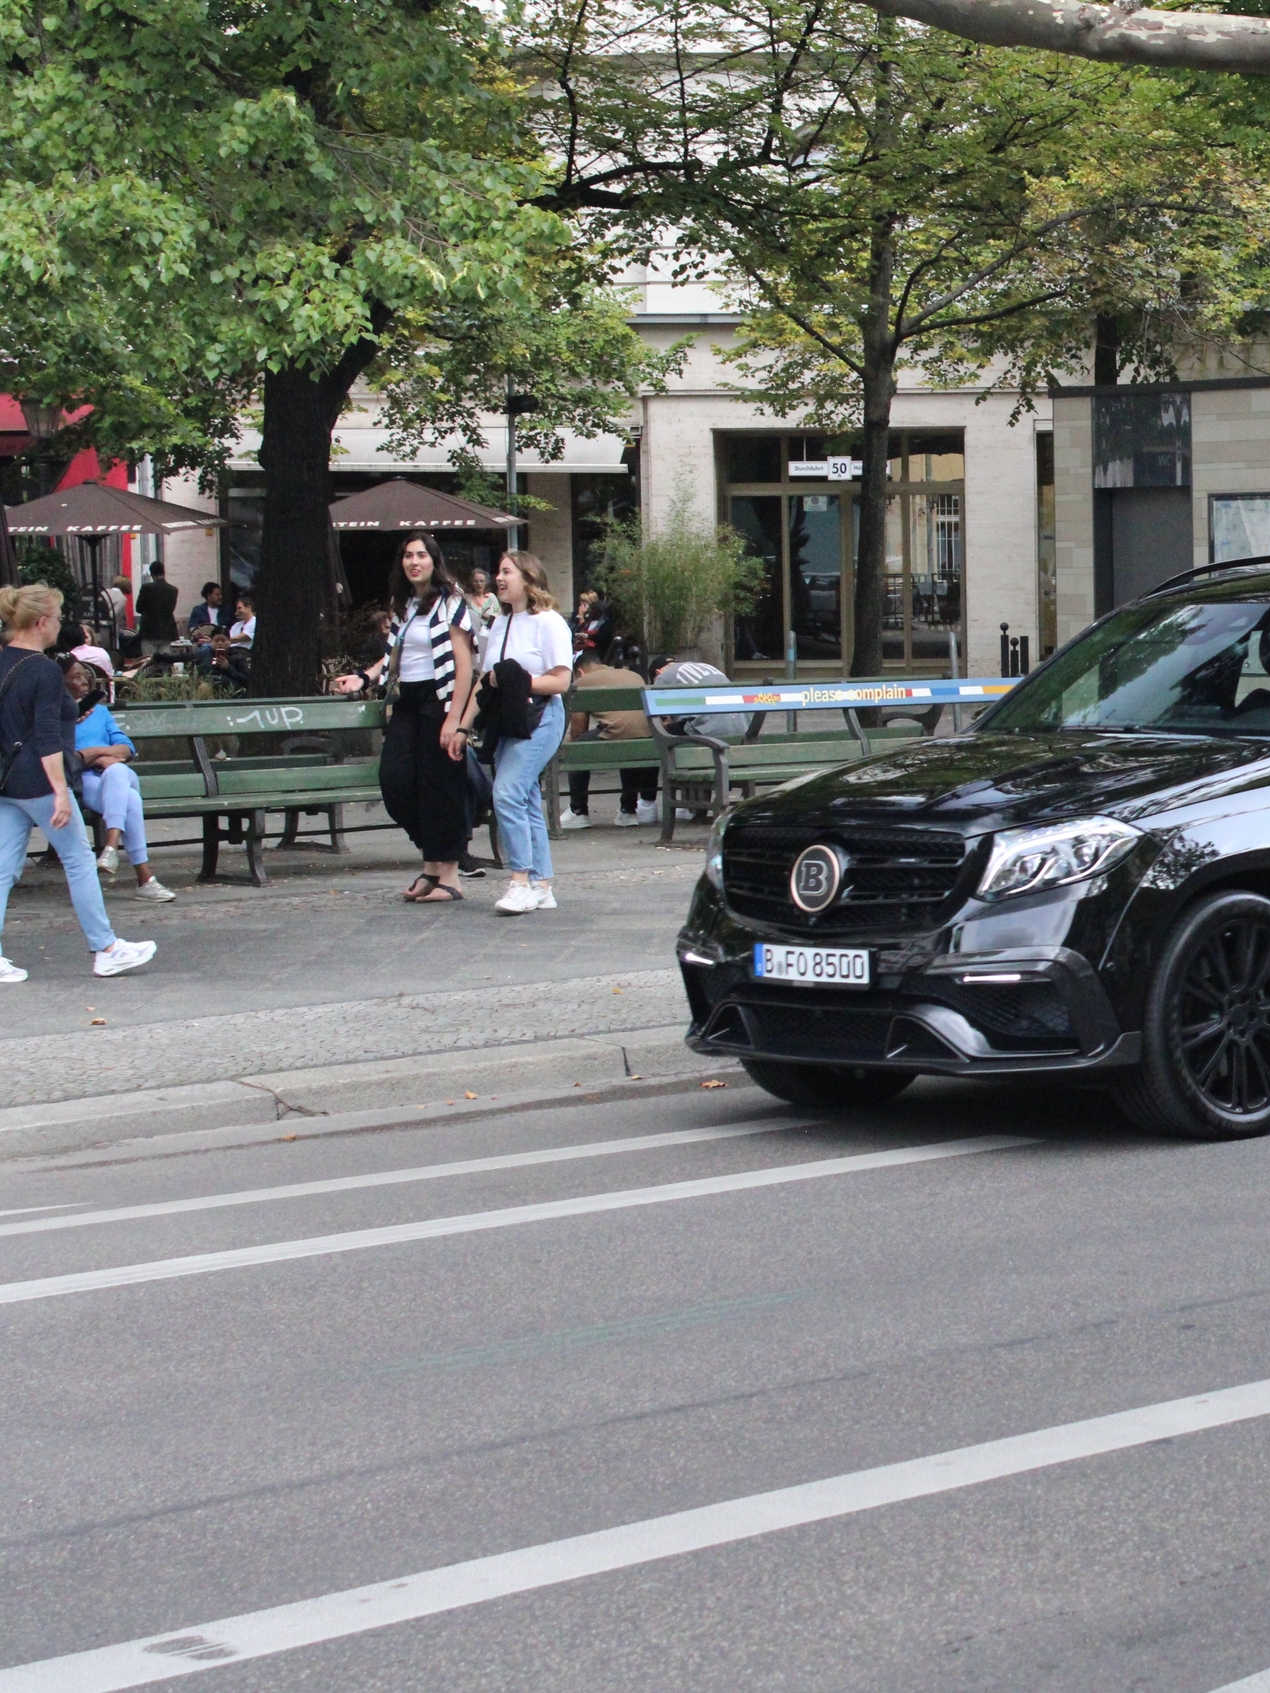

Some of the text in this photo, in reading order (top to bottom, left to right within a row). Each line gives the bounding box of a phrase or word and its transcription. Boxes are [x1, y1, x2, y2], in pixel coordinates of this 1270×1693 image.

[832, 462, 847, 474] 50
[66, 524, 143, 532] KAFFEE
[399, 519, 476, 527] KAFFEE
[801, 686, 844, 706] please
[848, 683, 907, 703] complain
[798, 860, 828, 896] B
[765, 948, 774, 973] B
[813, 952, 865, 979] 8500
